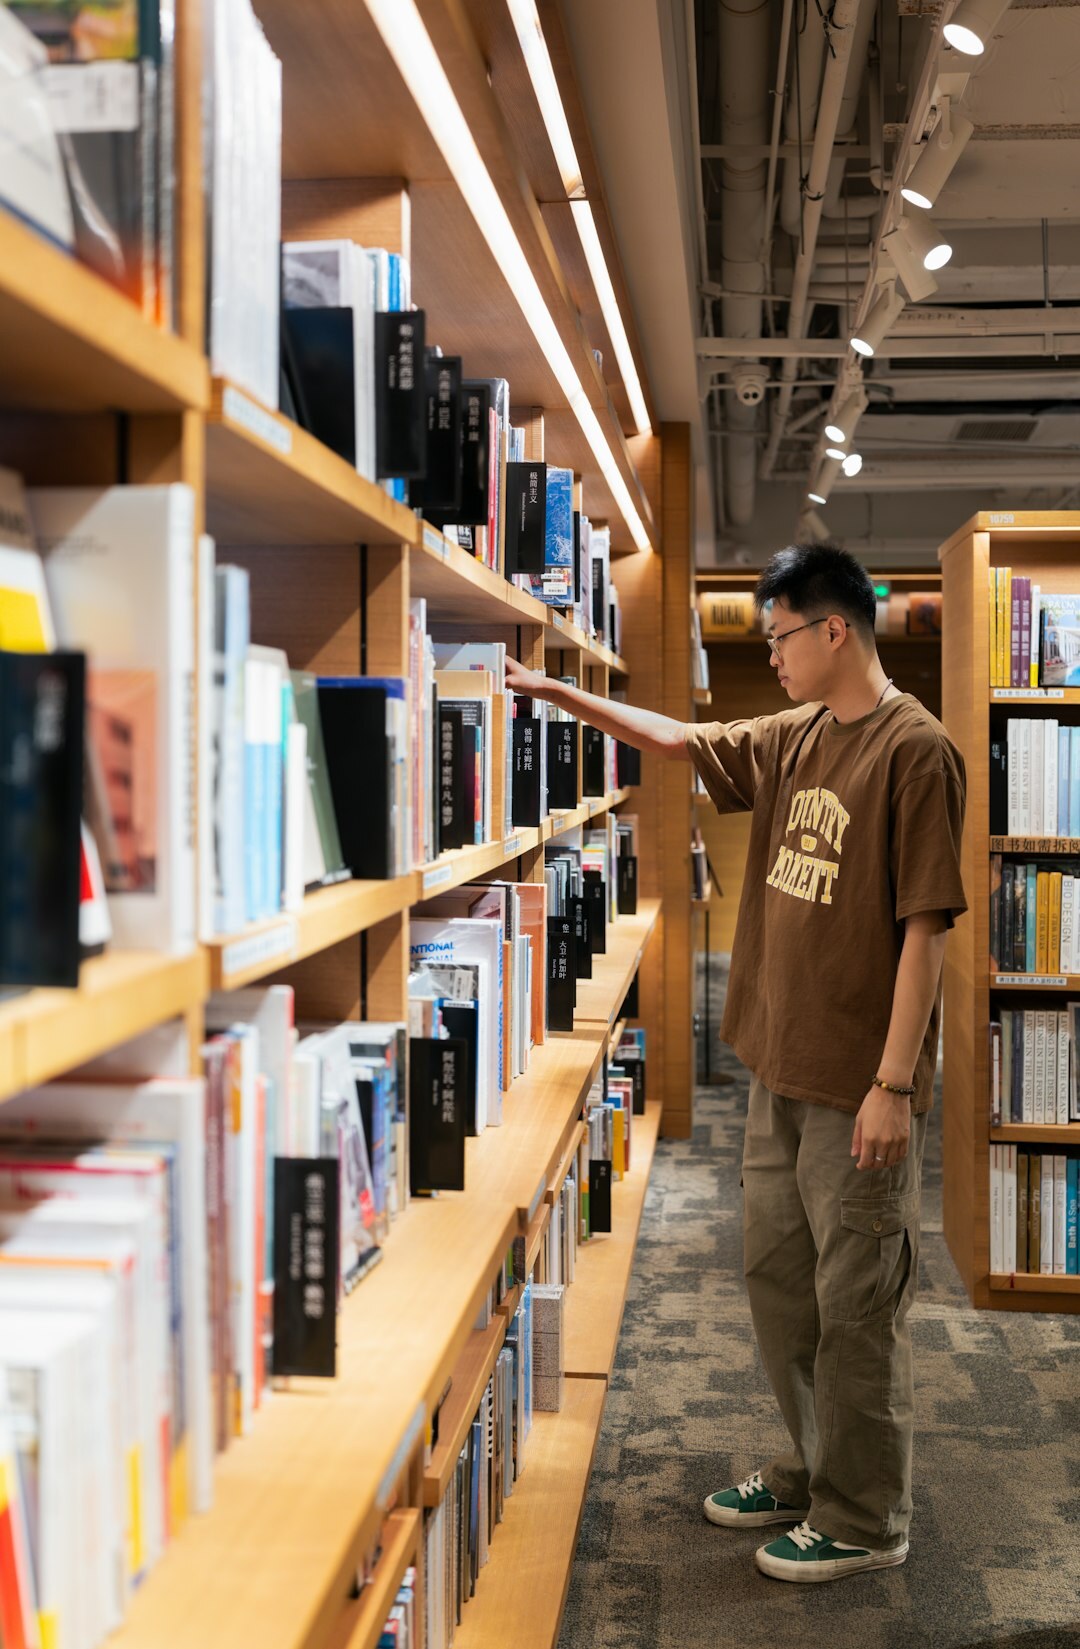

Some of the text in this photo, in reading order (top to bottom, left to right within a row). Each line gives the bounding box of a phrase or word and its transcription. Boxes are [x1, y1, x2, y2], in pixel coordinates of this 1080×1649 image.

[529, 471, 538, 504] 极简主义
[523, 727, 533, 771] 彼得·卒姆托
[563, 728, 571, 764] 扎哈·哈迪德
[991, 837, 1080, 851] 图书如需拆阅
[1062, 880, 1073, 943] BIO DESIGN
[558, 940, 567, 979] 大卫·阿加叶
[1025, 1014, 1033, 1112] LIVING IN THE FOREST
[1036, 1014, 1044, 1112] LIVING IN THE FOREST
[1047, 1014, 1056, 1112] LIVING IN THE DESERT
[1060, 1049, 1067, 1058] BY
[1068, 1199, 1078, 1249] Bath & Spa
